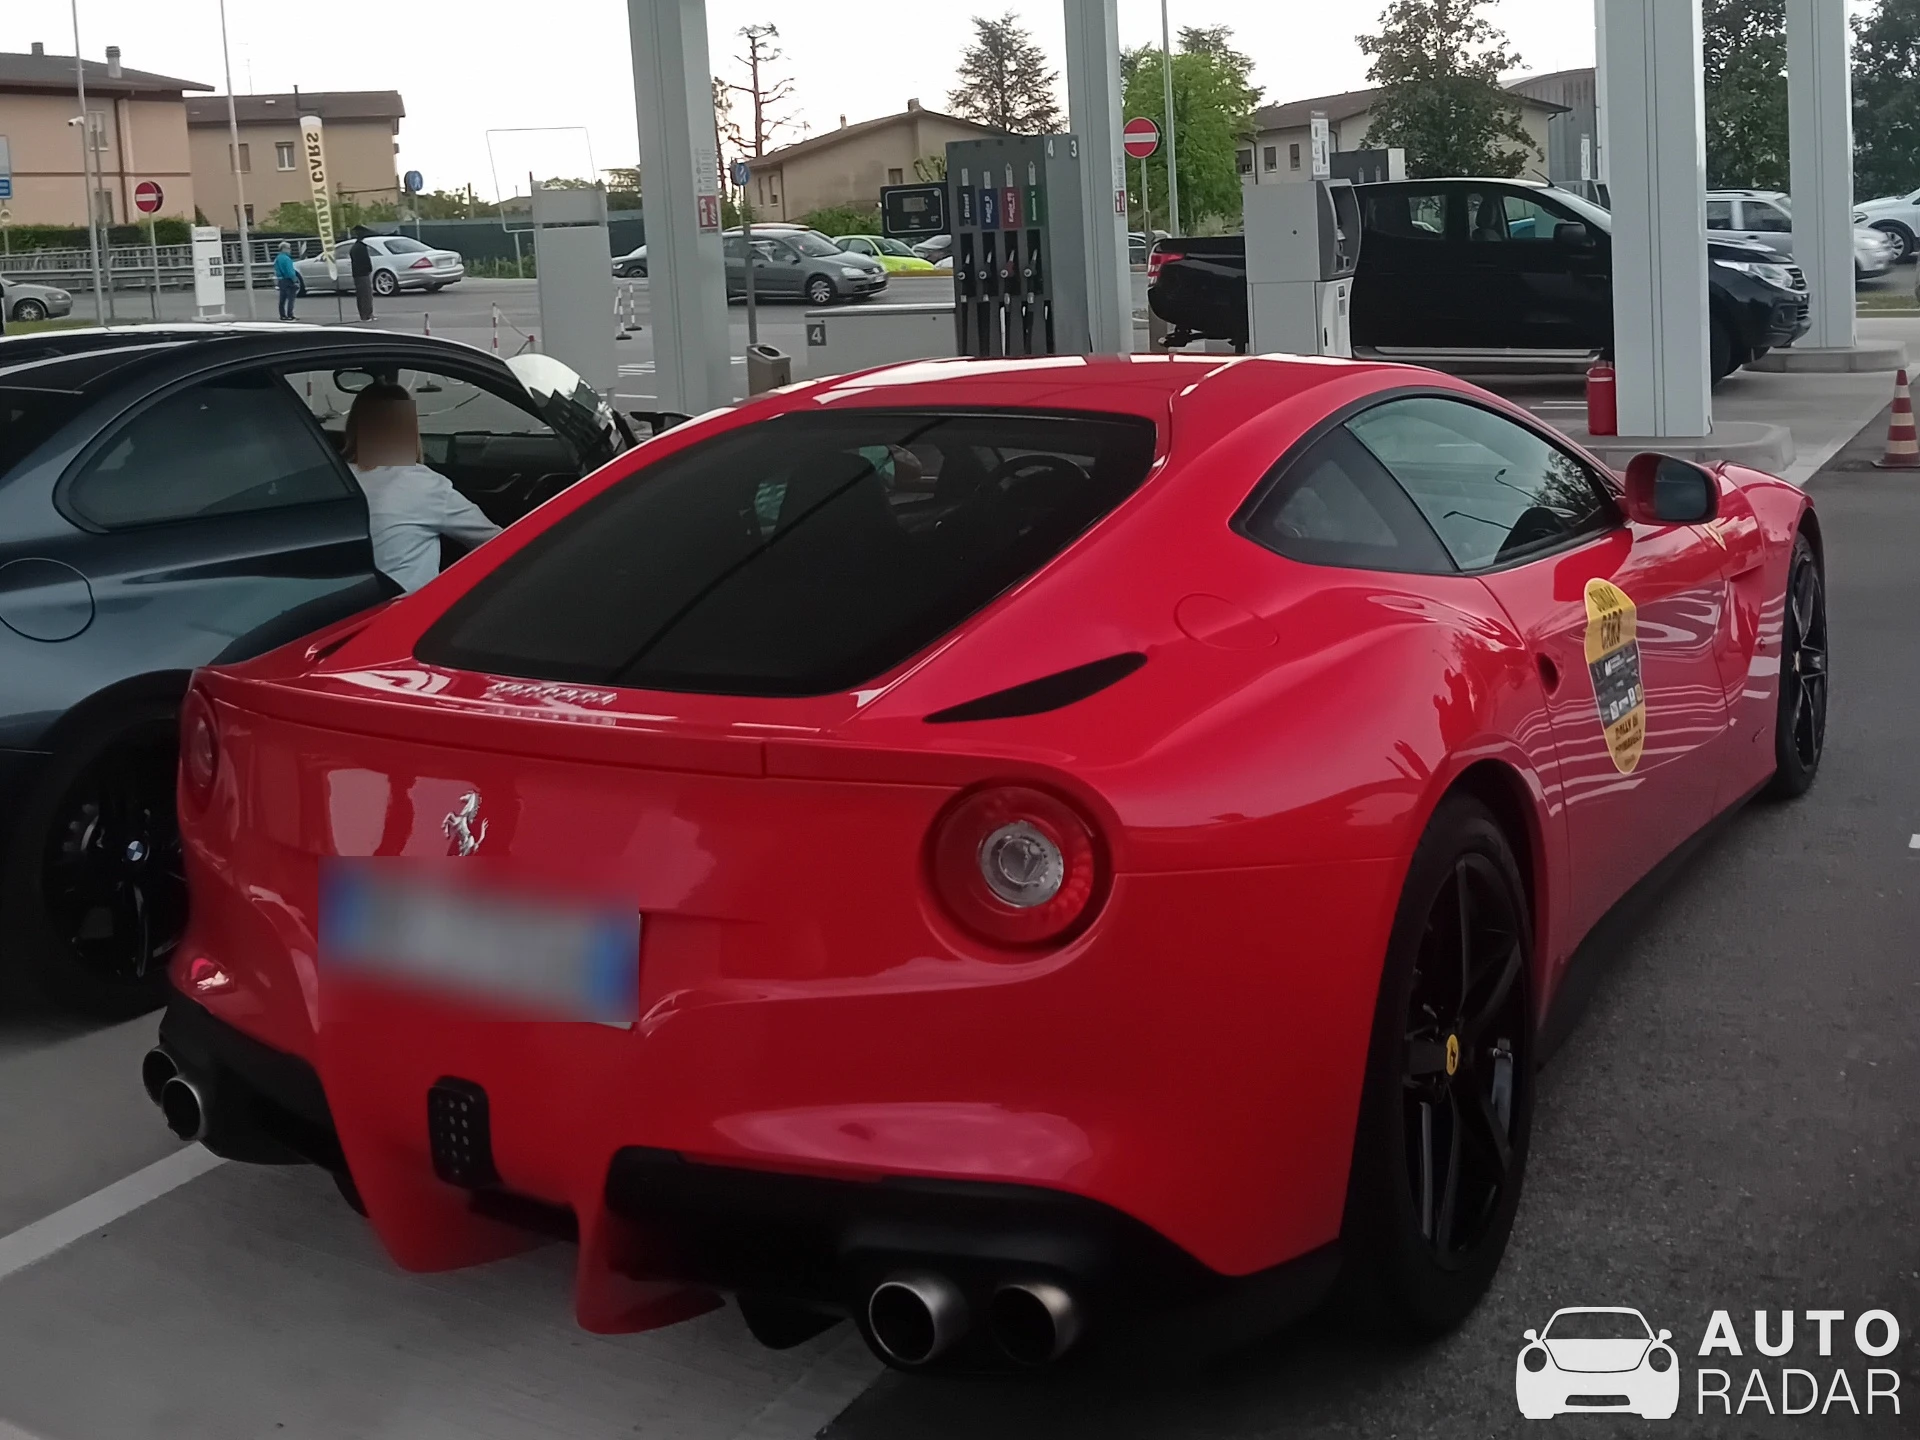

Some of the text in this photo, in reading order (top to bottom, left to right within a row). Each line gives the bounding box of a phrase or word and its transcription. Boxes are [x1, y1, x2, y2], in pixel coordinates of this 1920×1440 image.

[1047, 139, 1054, 157] 4
[1070, 140, 1077, 158] 3
[811, 326, 823, 344] 4
